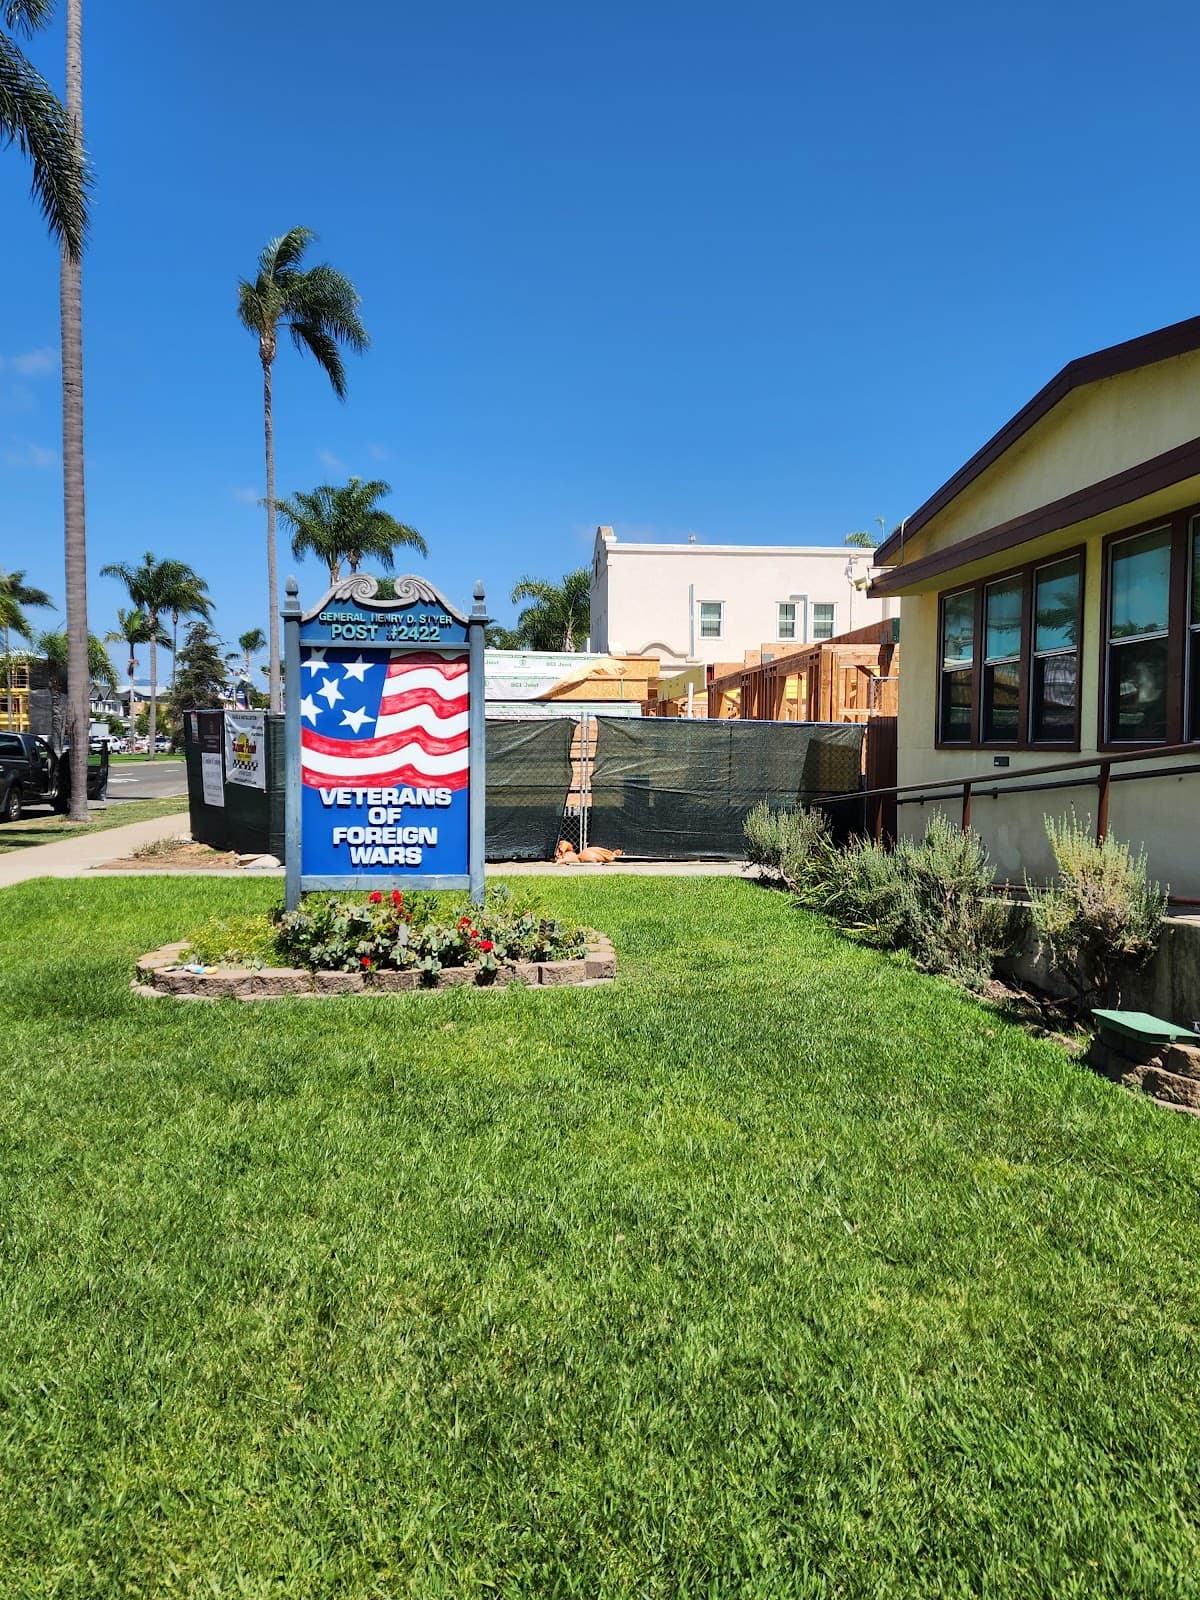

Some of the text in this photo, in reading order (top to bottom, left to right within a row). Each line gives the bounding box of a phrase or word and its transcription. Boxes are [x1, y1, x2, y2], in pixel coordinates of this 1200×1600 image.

[319, 612, 366, 622] GENERAL
[371, 613, 404, 623] HENRY
[407, 614, 417, 624] D.
[331, 623, 440, 640] POST #2422
[319, 787, 452, 806] VETERANS
[368, 806, 401, 825] OF
[332, 826, 438, 845] FOREIGN
[350, 846, 423, 865] WARS
